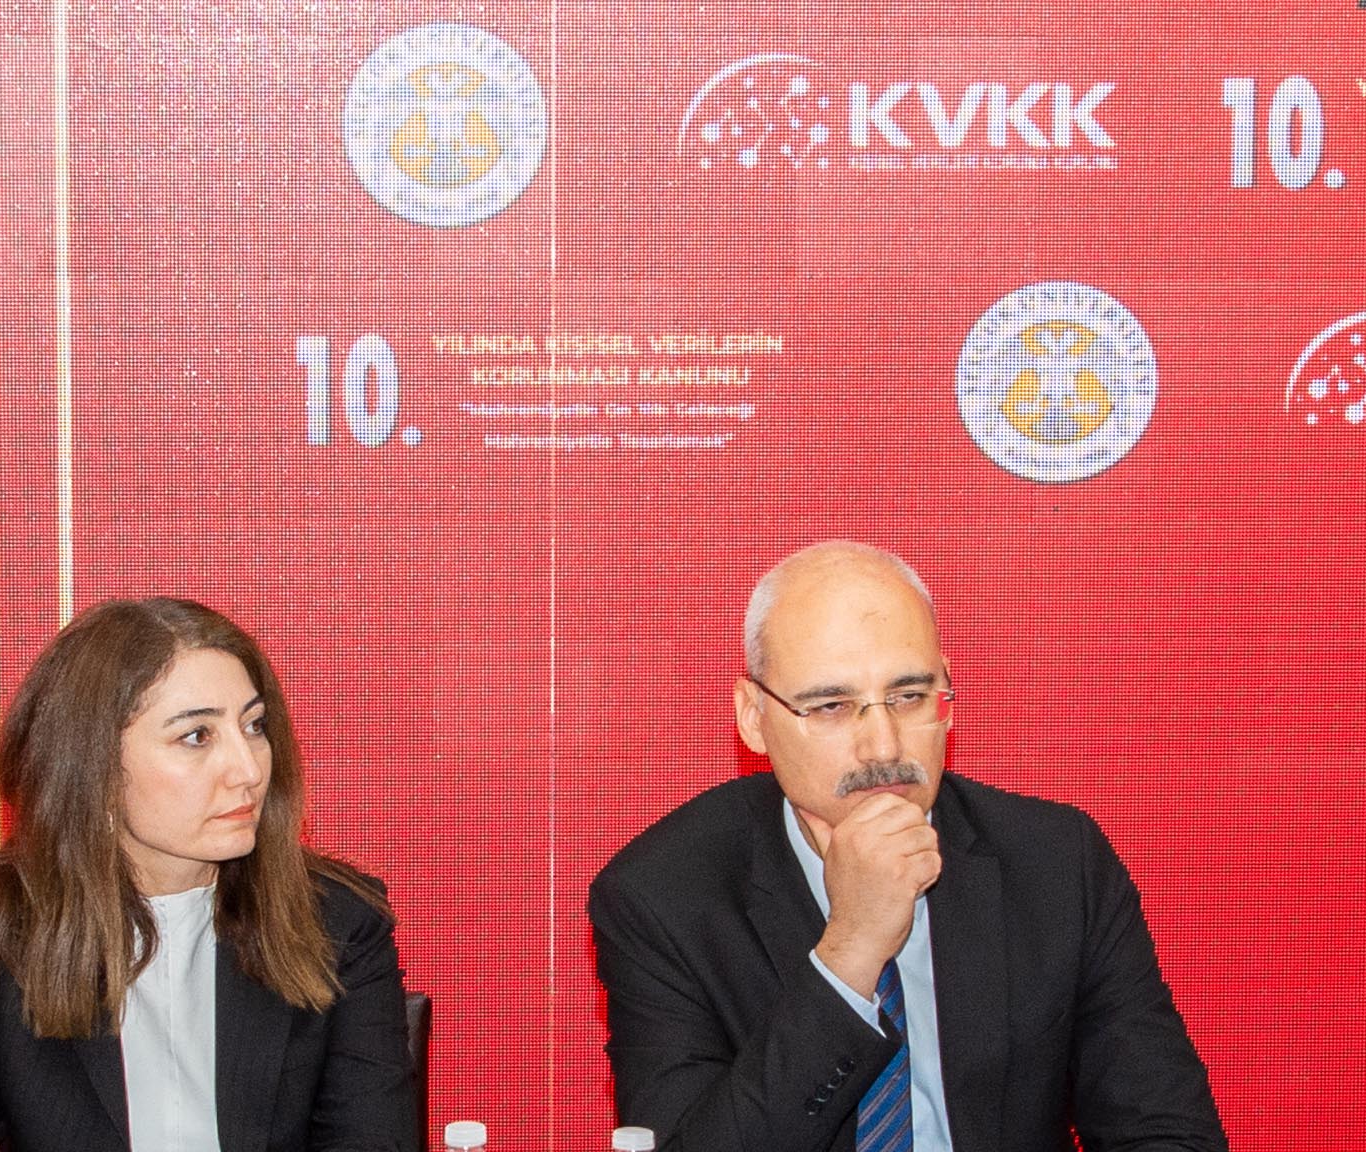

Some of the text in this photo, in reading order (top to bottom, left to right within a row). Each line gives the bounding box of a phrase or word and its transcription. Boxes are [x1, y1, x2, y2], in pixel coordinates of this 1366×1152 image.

[849, 82, 1114, 148] KVKK
[1221, 75, 1344, 189] 10.
[295, 333, 420, 446] 10.
